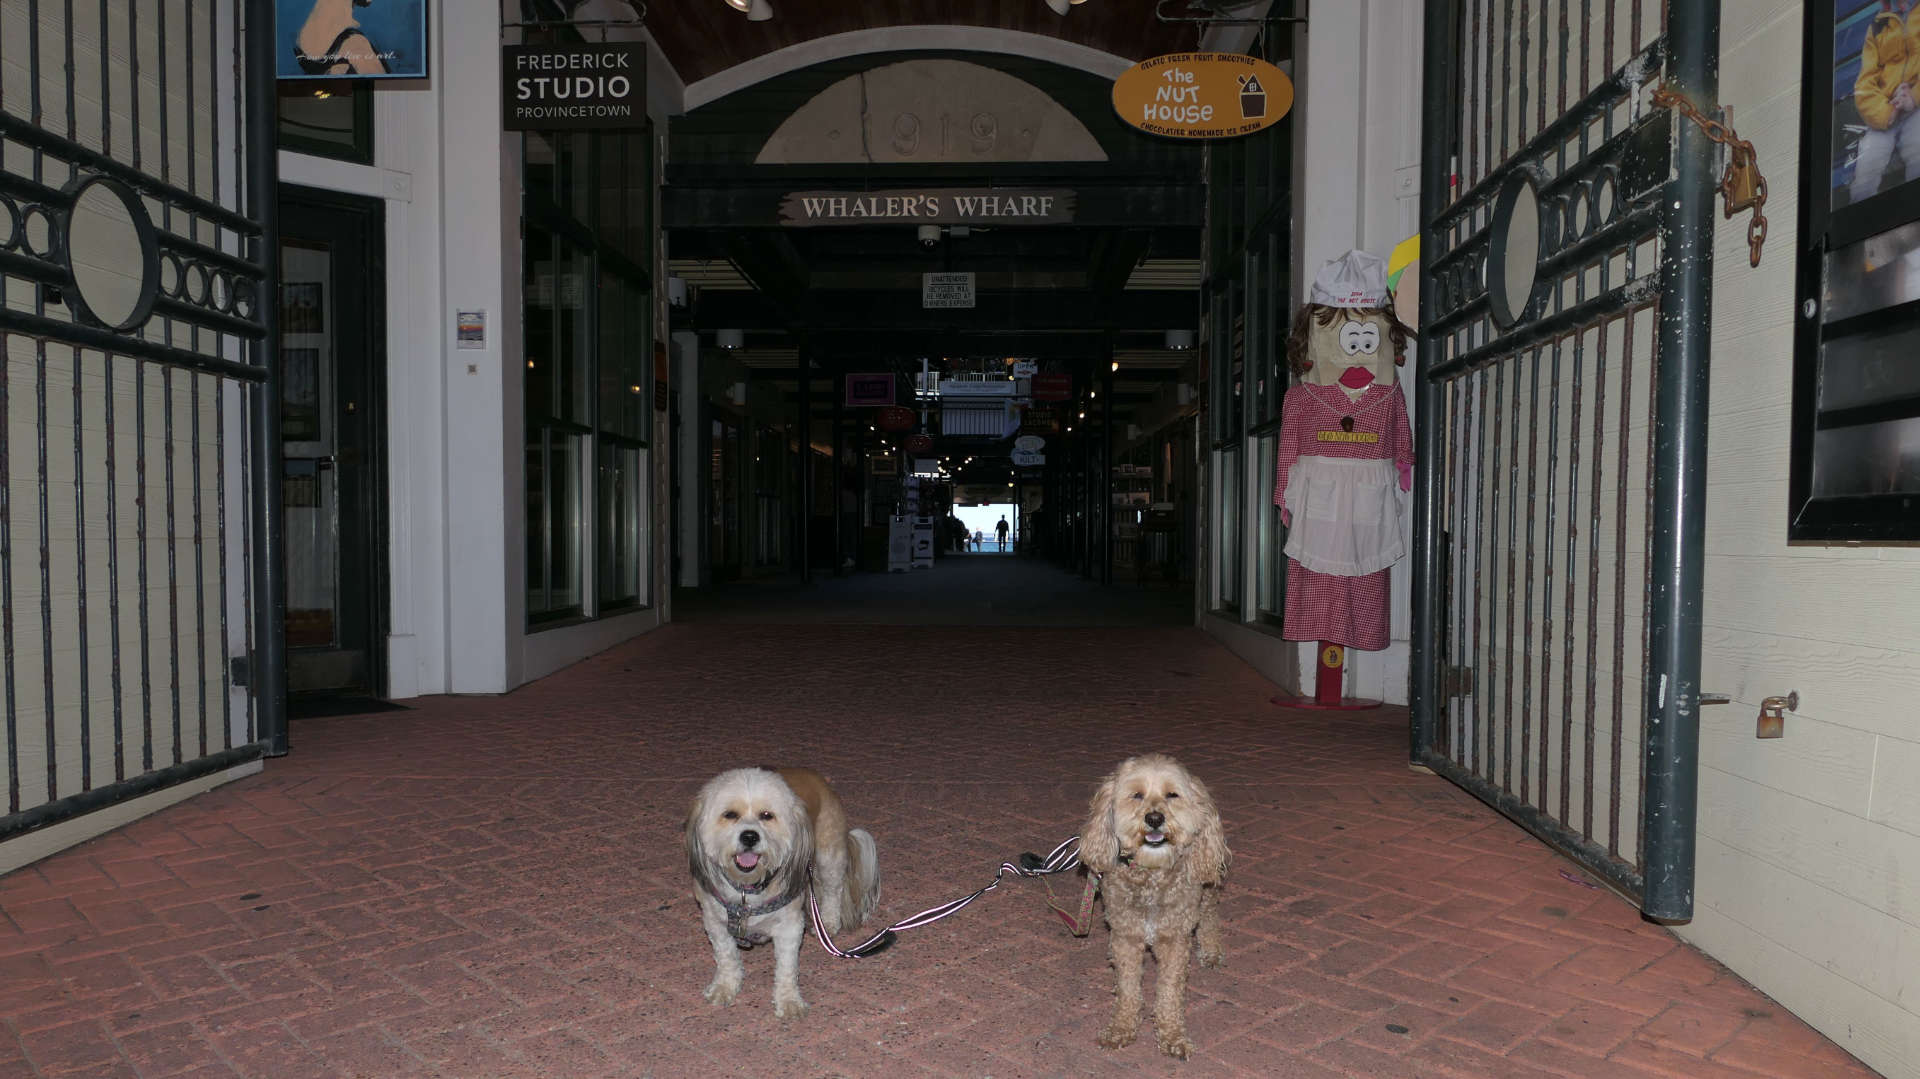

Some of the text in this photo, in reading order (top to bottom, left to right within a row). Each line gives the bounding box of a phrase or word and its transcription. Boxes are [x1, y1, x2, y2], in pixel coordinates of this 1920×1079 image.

[516, 53, 630, 70] FREDERICK
[1193, 54, 1214, 63] FRUIT
[1162, 68, 1194, 83] The
[516, 76, 630, 100] STUDIO
[1156, 85, 1200, 103] NUT
[516, 105, 631, 119] PROVINCETOWN
[1188, 129, 1224, 137] HOMEMADE
[801, 195, 1055, 218] WHALER'S WHARF
